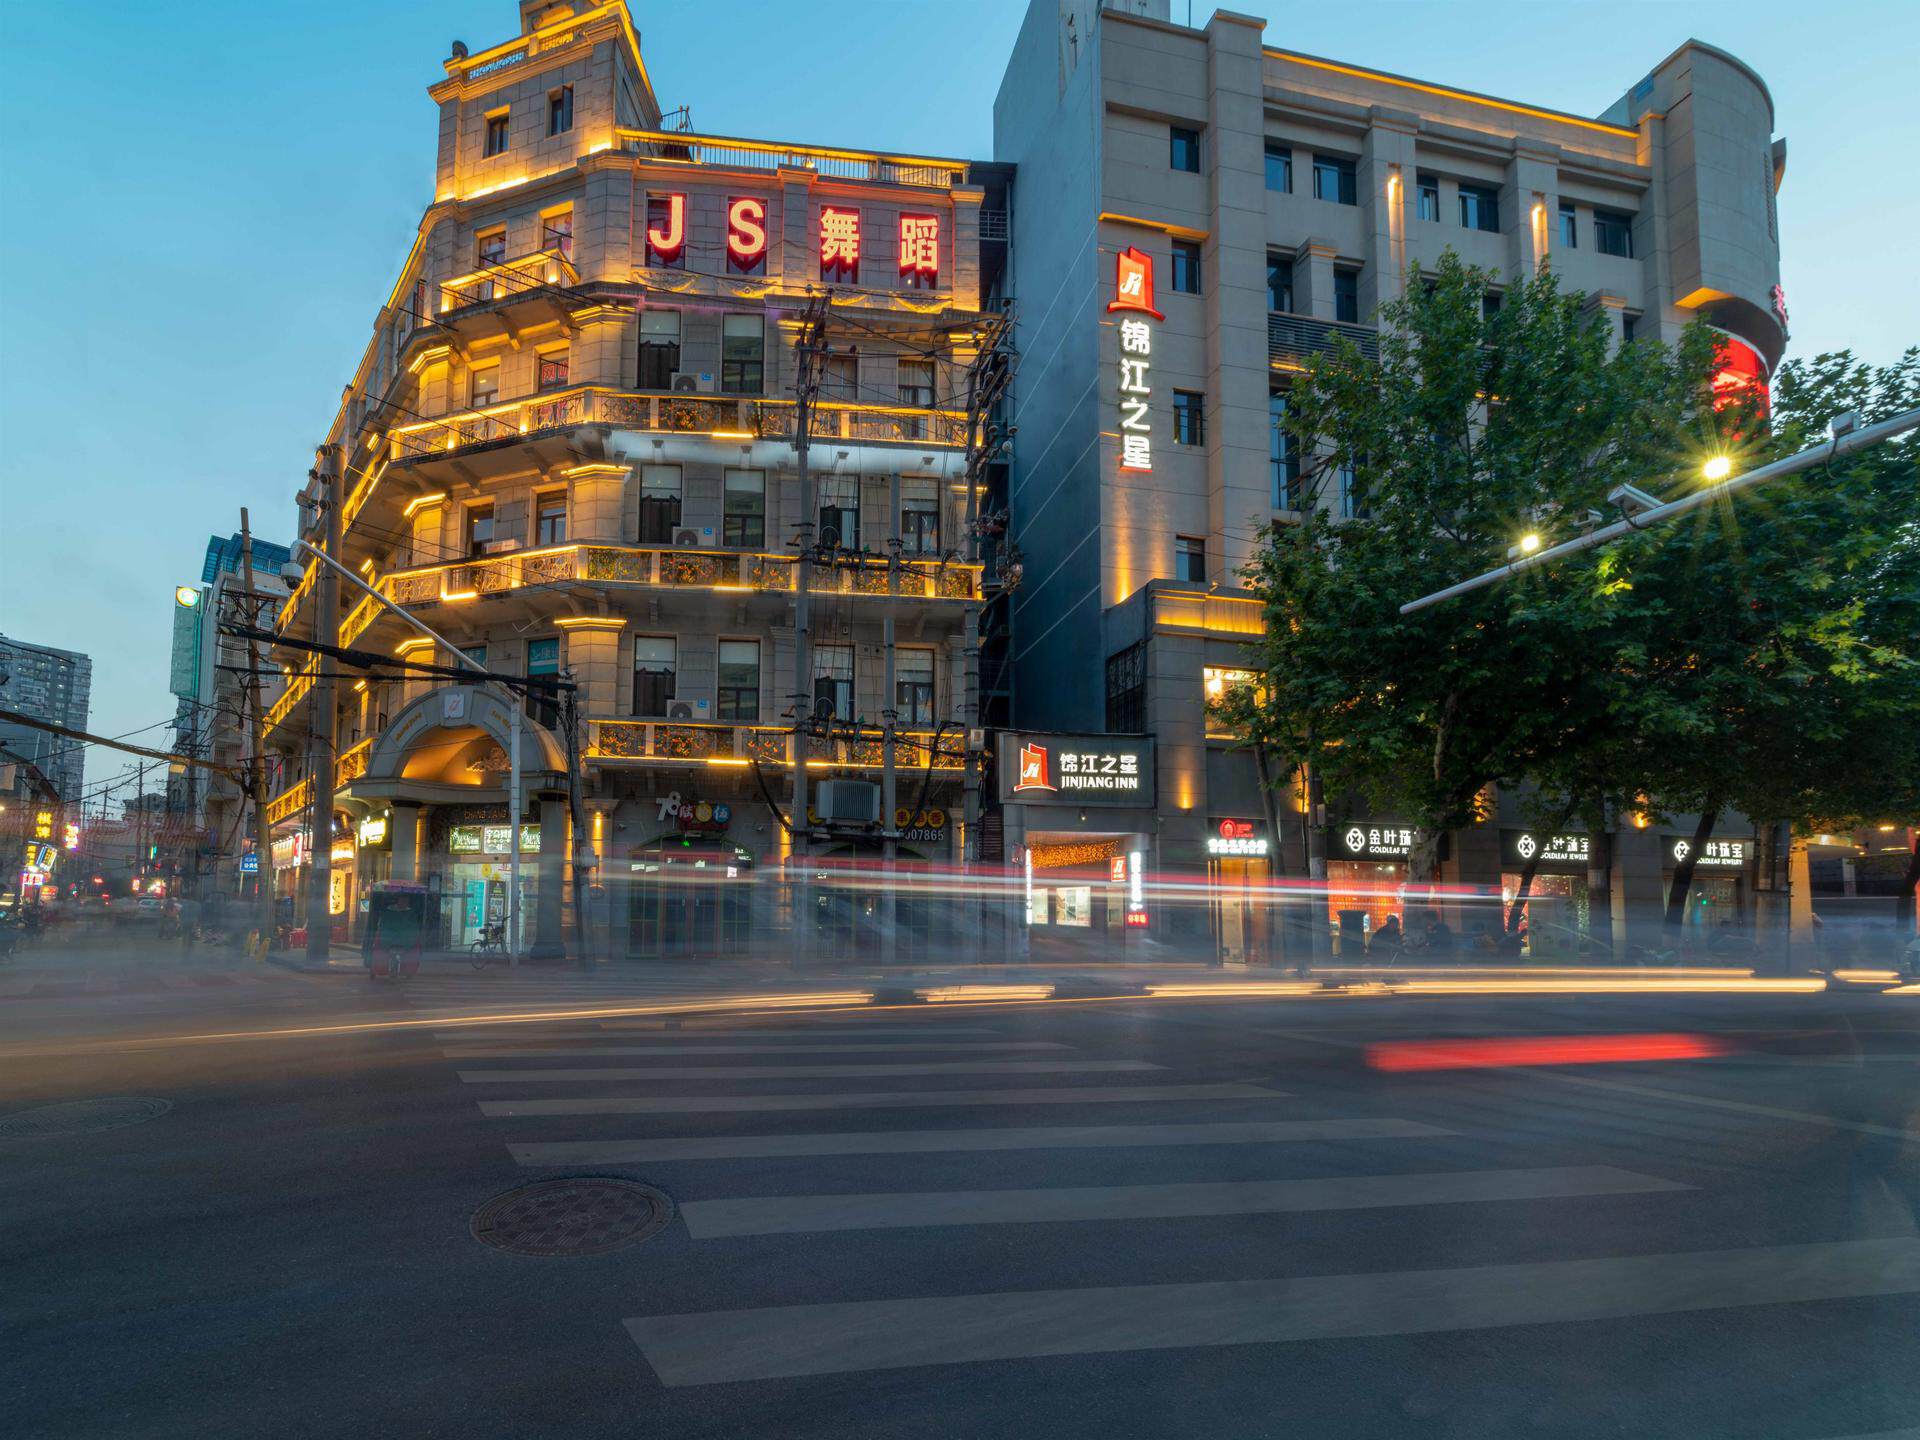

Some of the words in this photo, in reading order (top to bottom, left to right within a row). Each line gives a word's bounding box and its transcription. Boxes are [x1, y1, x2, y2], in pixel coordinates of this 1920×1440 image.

[1120, 319, 1151, 469] 锦江之星
[1060, 753, 1138, 774] 锦江之星
[1061, 776, 1113, 789] JINJIANG
[1115, 777, 1138, 789] INN
[1369, 829, 1417, 846] 金叶珠
[1706, 842, 1743, 858] 叶珠宝
